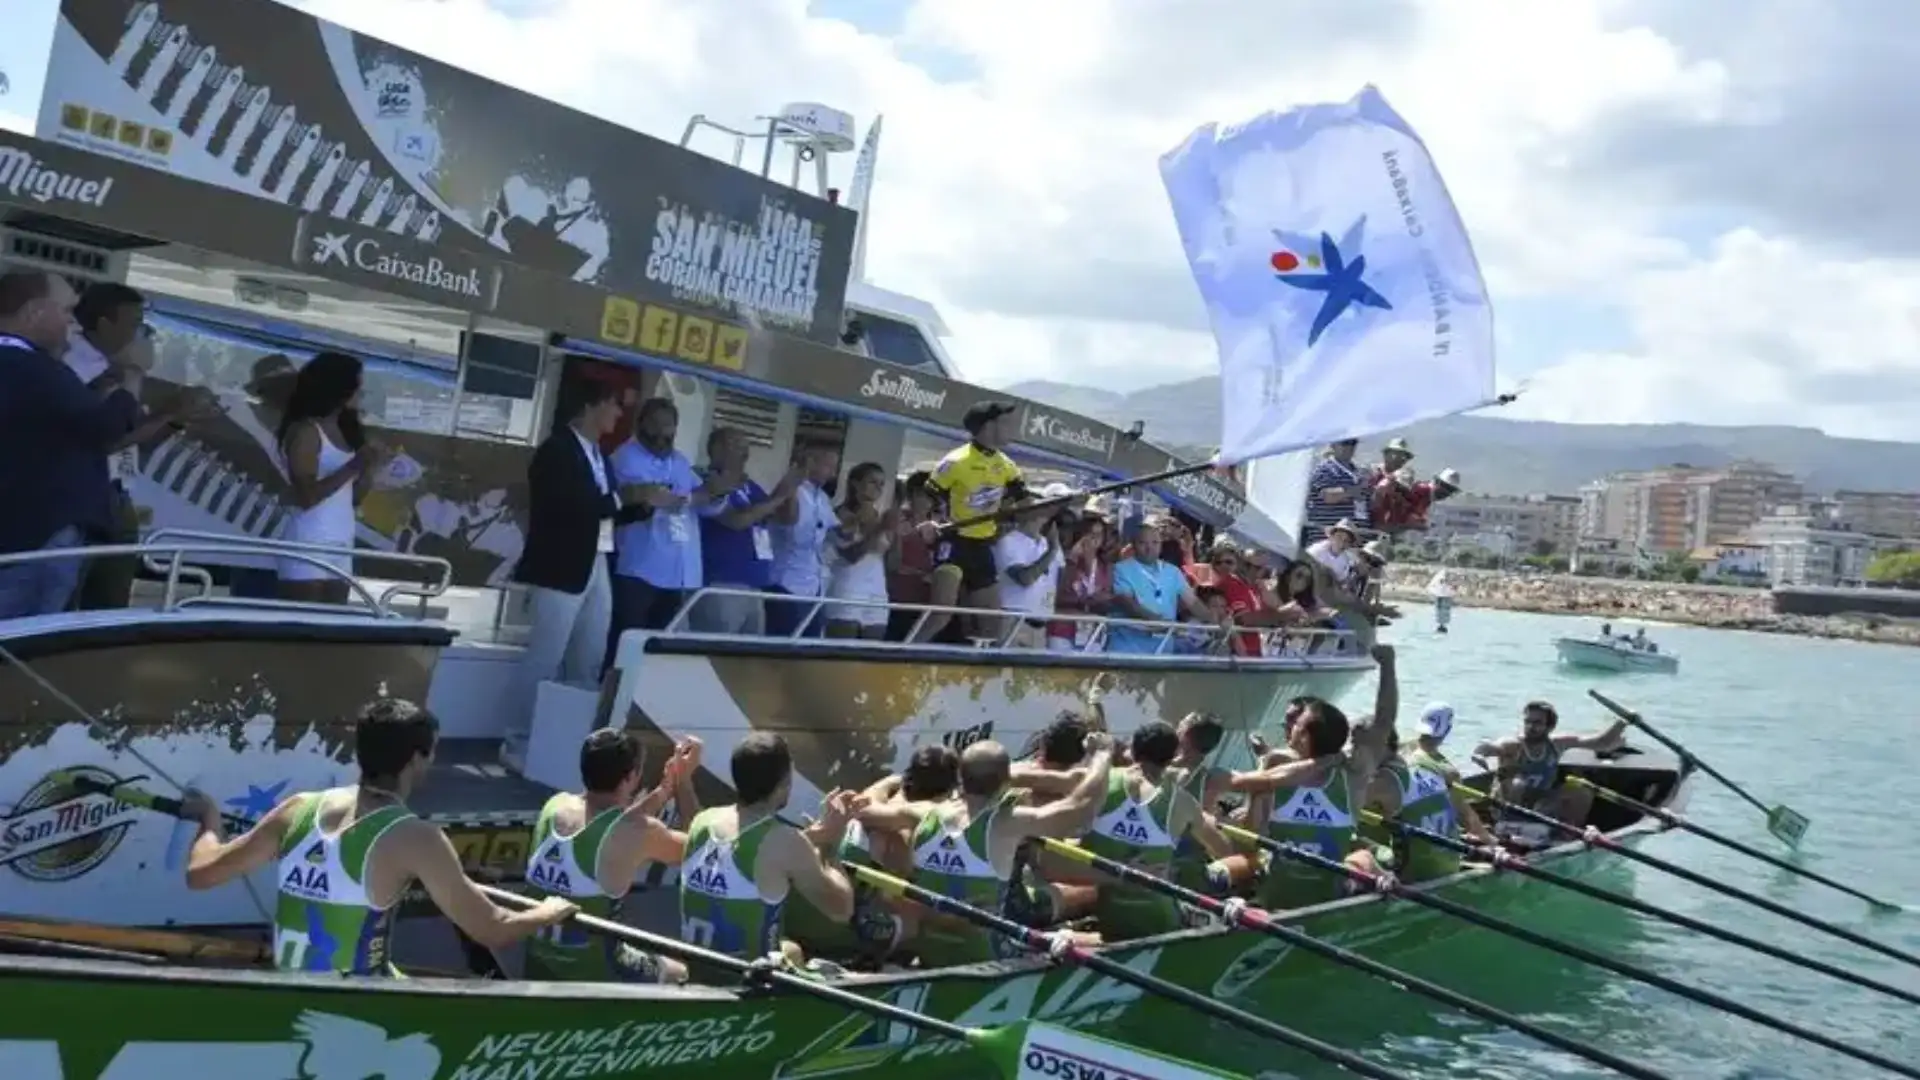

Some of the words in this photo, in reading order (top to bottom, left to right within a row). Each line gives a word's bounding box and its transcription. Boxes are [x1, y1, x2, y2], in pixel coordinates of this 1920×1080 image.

[651, 209, 721, 269] SAN
[718, 226, 820, 294] MIGUEL
[354, 239, 481, 297] CaixaBank
[1293, 807, 1333, 821] AIA
[1112, 821, 1149, 840] AIA
[926, 852, 966, 868] AIA
[285, 864, 329, 892] AIA
[531, 864, 571, 888] AIA
[689, 866, 729, 890] AIA
[466, 1016, 739, 1061] NEUMÁTICOS
[746, 1010, 776, 1033] Y
[447, 1030, 776, 1080] MANTENIMIENTO
